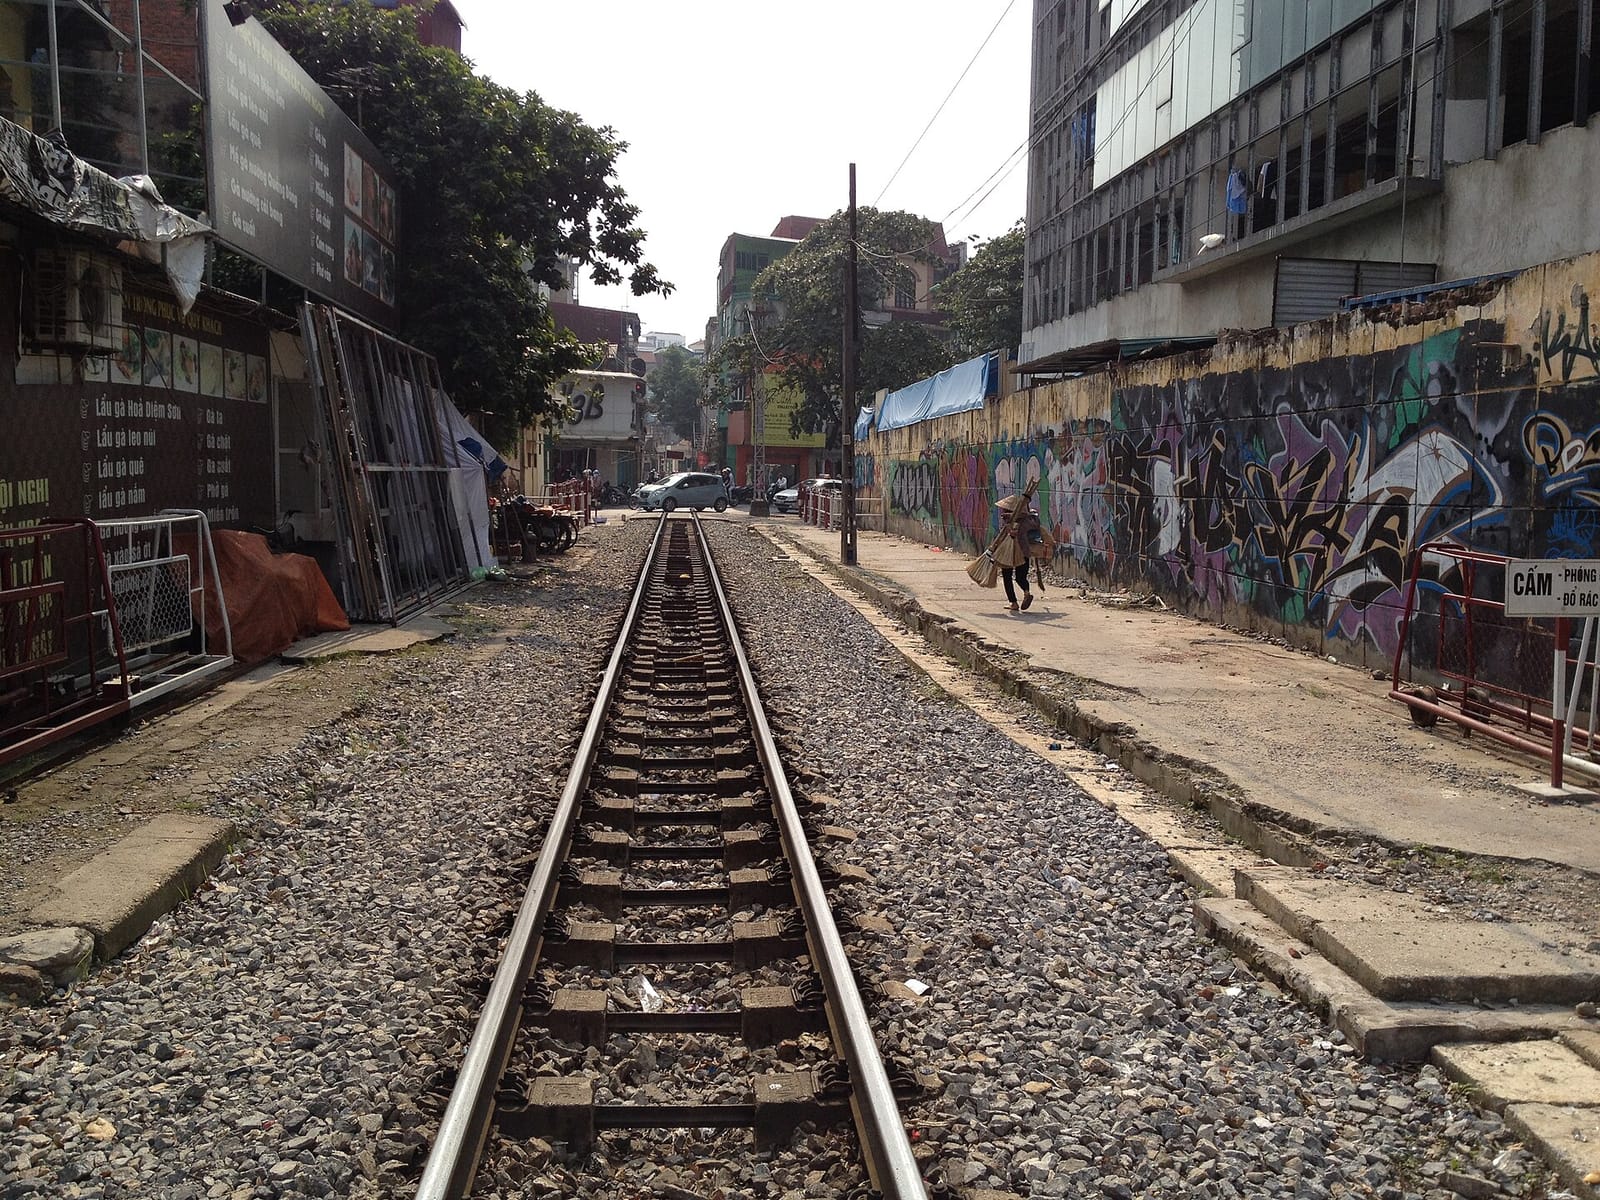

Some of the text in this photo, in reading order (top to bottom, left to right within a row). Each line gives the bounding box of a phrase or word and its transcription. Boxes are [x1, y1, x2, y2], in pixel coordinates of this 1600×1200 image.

[114, 397, 126, 418] gà
[115, 427, 126, 448] gà
[128, 429, 142, 446] leo
[116, 457, 126, 478] gà
[116, 487, 126, 508] gà
[1514, 565, 1552, 596] CẤM
[1564, 566, 1597, 582] PHÓNG
[1563, 586, 1599, 607] ĐỔ RÁC
